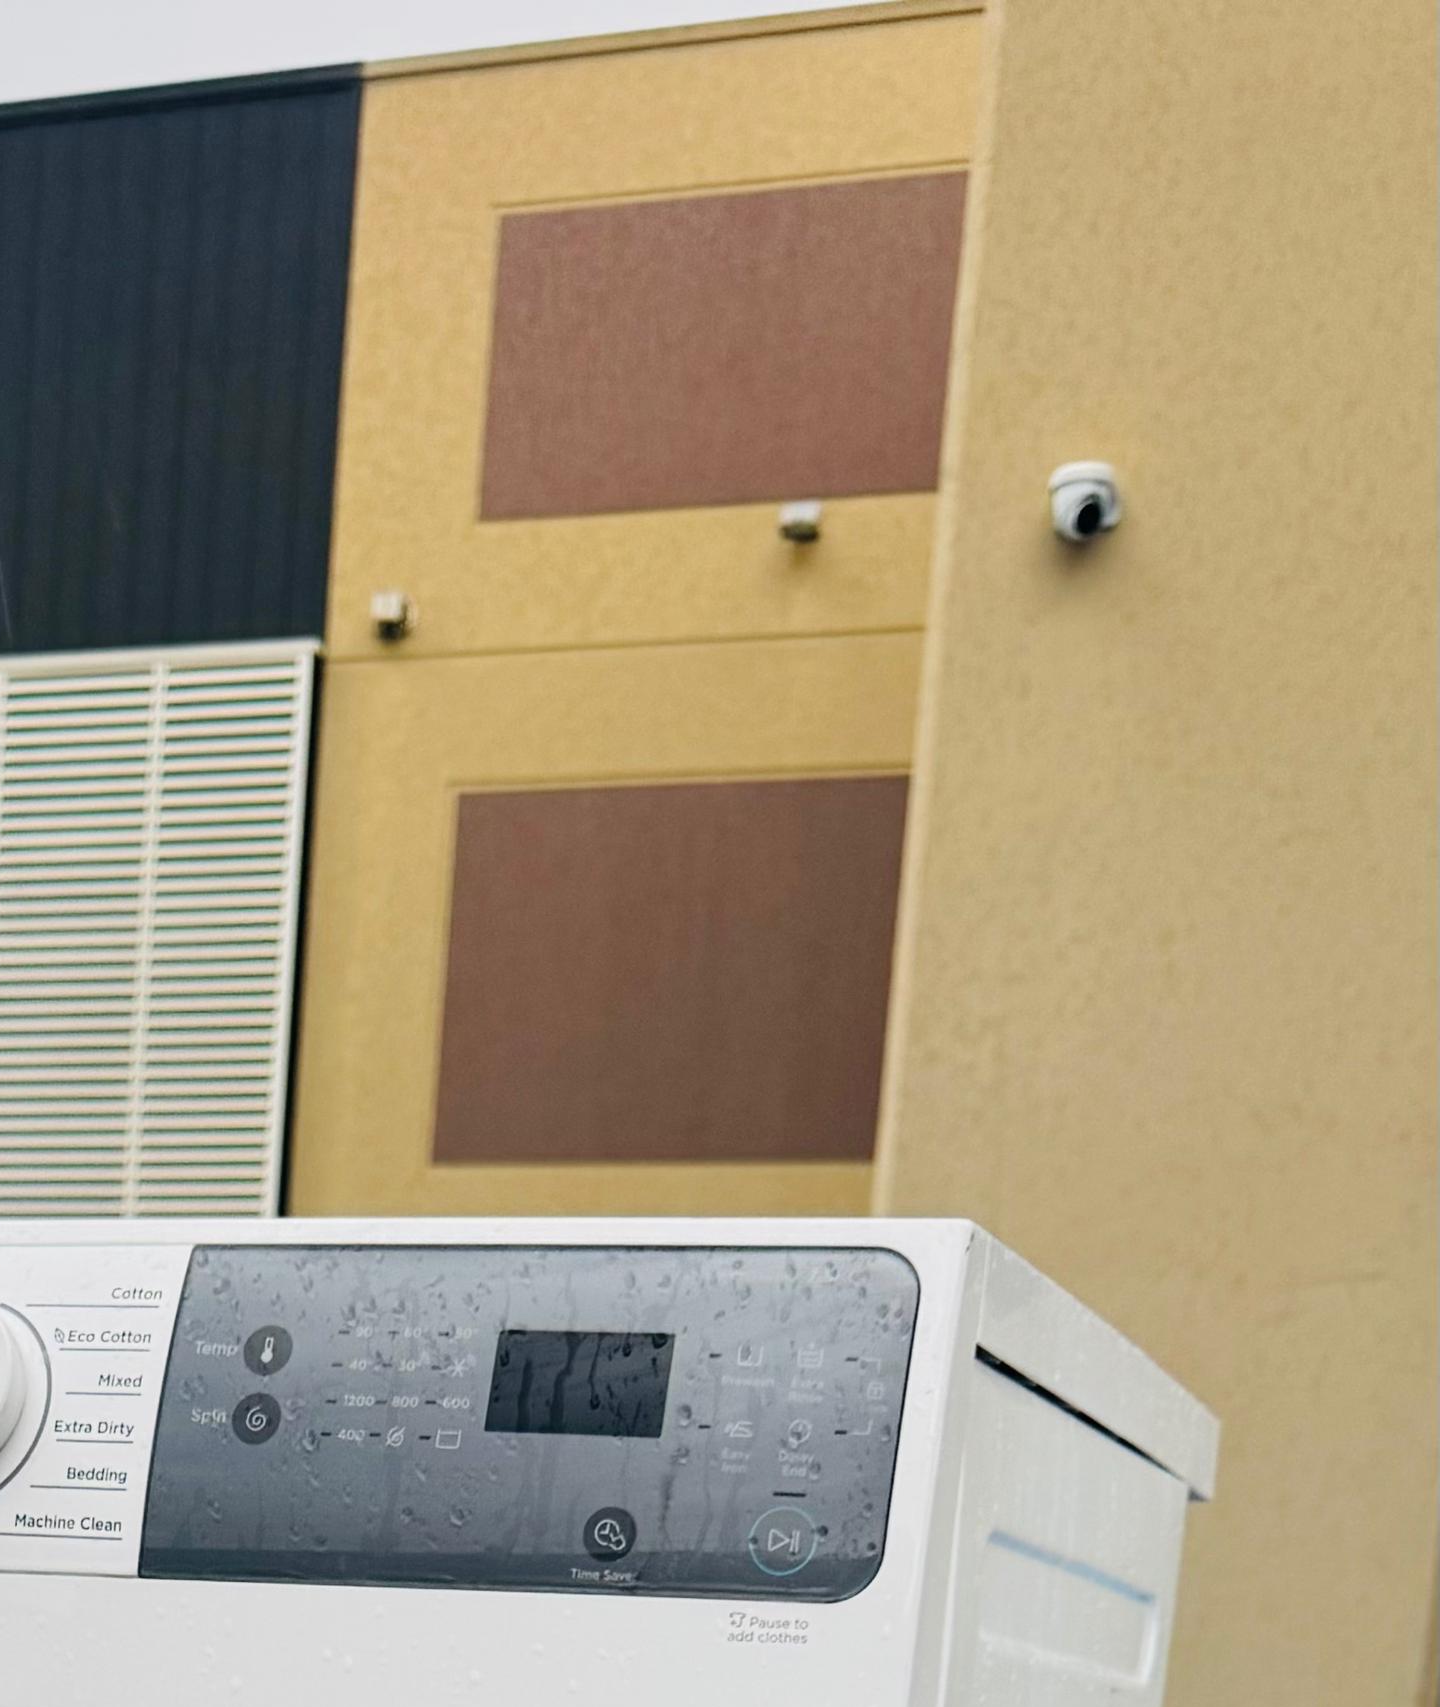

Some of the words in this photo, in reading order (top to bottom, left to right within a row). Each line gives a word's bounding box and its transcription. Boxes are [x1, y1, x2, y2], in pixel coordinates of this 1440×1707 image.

[111, 1287, 162, 1300] Cotton
[67, 1330, 96, 1344] Eco
[100, 1330, 152, 1344] Cotton
[195, 1340, 239, 1357] Temp
[98, 1373, 143, 1388] Mixed
[344, 1394, 375, 1407] 1200
[391, 1396, 420, 1408] 800
[442, 1396, 470, 1408] 600
[191, 1407, 227, 1425] Spin
[54, 1419, 92, 1434] Extra
[96, 1421, 135, 1439] Dirty
[66, 1467, 127, 1486] Bedding
[781, 1464, 808, 1478] End
[14, 1513, 76, 1531] Machine
[80, 1515, 122, 1532] Clean
[570, 1567, 600, 1580] Time
[749, 1616, 790, 1629] Pause
[794, 1618, 809, 1630] to
[727, 1631, 754, 1643] add
[758, 1632, 808, 1644] clothes
